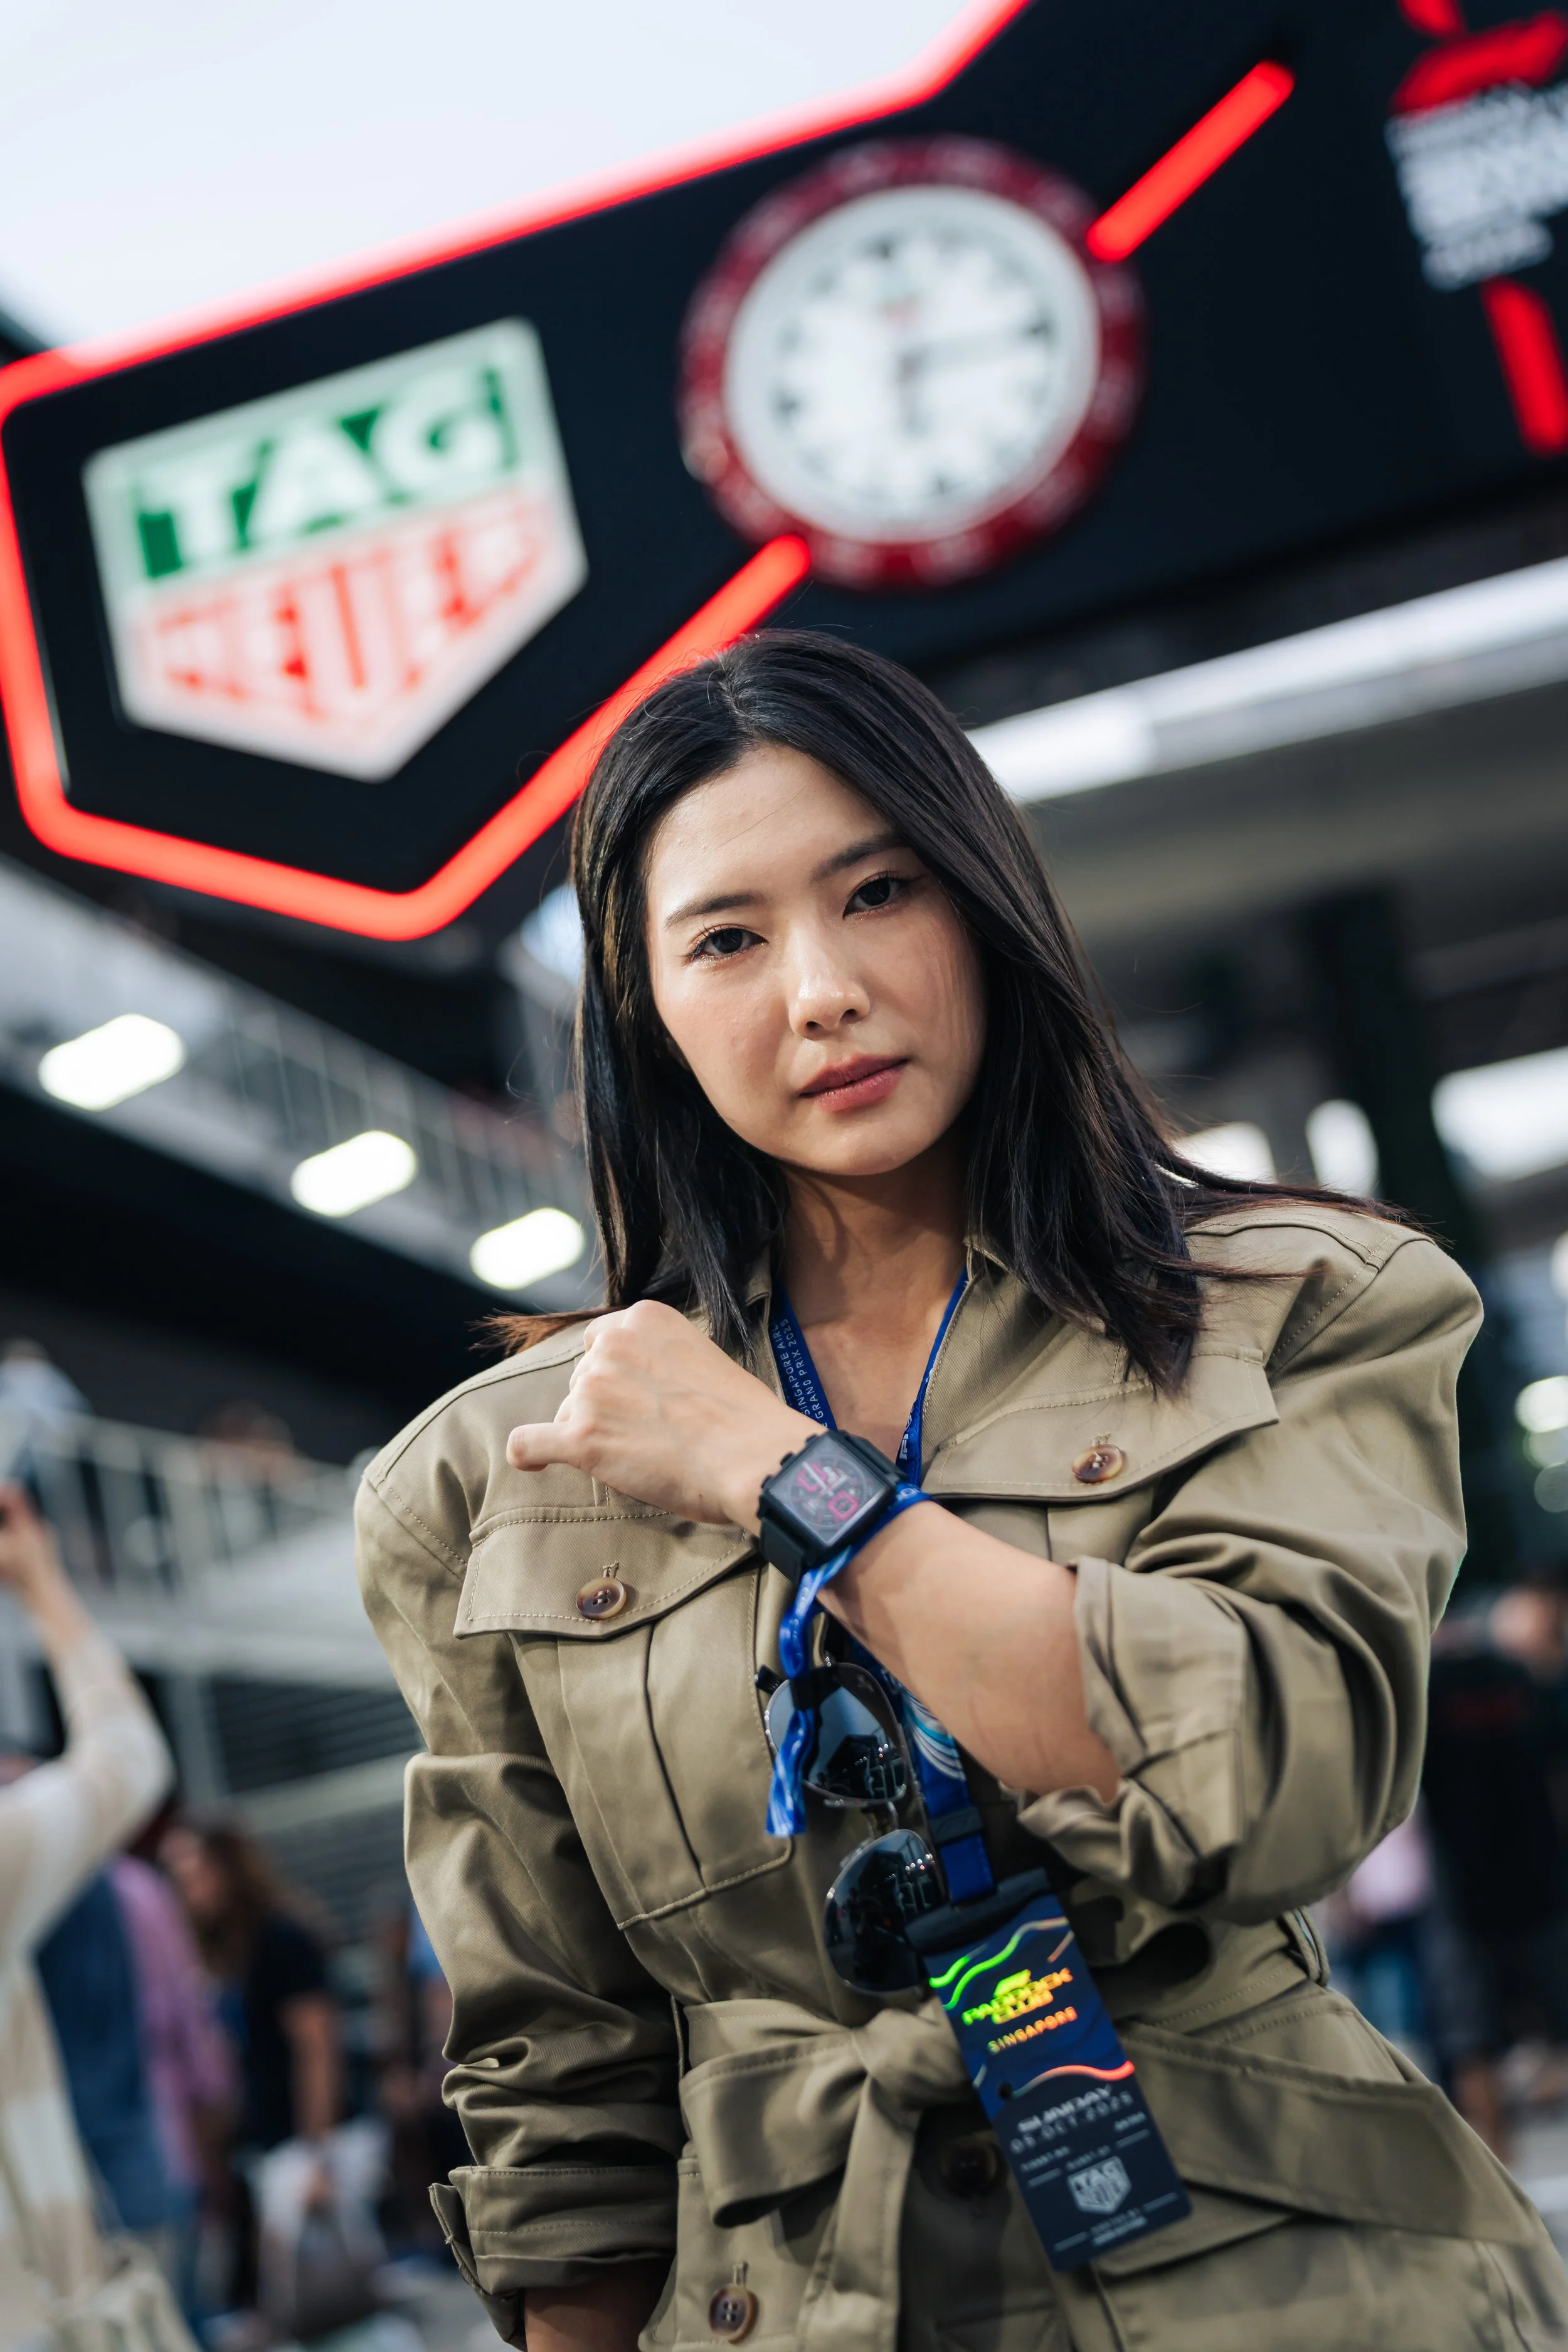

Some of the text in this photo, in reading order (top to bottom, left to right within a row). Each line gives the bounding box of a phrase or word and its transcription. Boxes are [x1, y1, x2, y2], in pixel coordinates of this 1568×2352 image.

[135, 359, 509, 564] TAG
[780, 1318, 797, 1347] 2025
[780, 1352, 810, 1416] SINGAPORE
[792, 1349, 807, 1376] PRIX
[803, 1379, 824, 1419] GRAND
[987, 2006, 1078, 2055] SINGAPORE
[1017, 2083, 1113, 2133] SUNDAY
[1071, 2161, 1123, 2191] TAG
